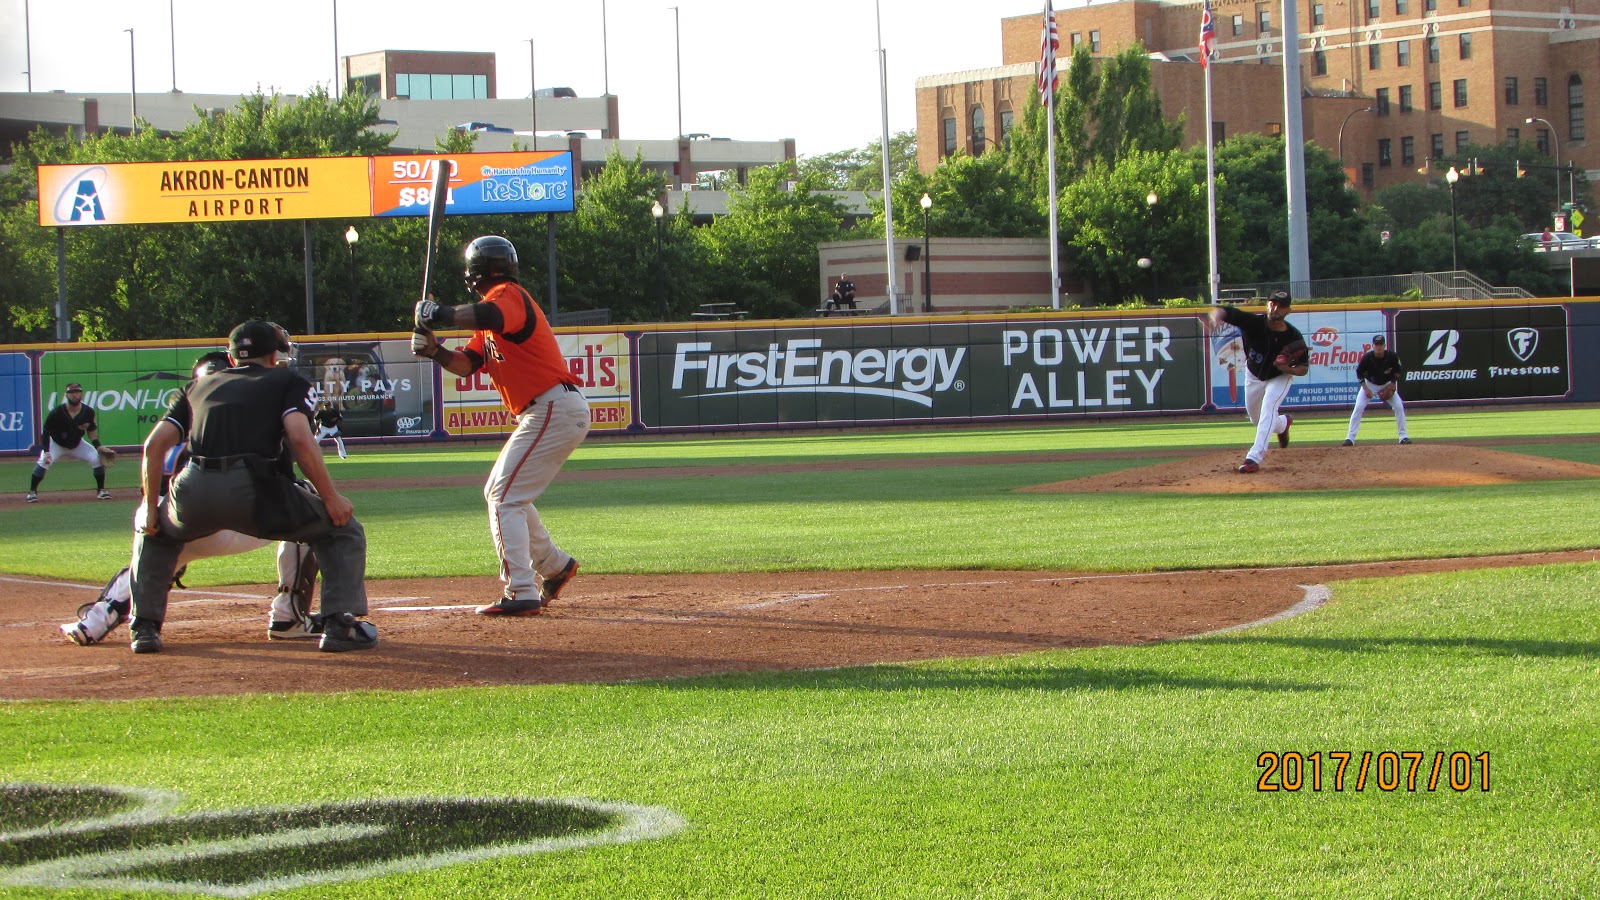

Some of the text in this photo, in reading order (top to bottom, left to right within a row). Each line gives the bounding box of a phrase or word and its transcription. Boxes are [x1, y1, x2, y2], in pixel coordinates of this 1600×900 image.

[160, 167, 309, 191] AKRON-CANTON
[393, 159, 459, 179] 50/0
[493, 166, 564, 176] Habitat for Humanity
[399, 187, 455, 207] $81
[482, 178, 567, 201] ReStore
[188, 197, 284, 217] AIRPORT
[1003, 326, 1173, 366] POWER
[1315, 332, 1336, 342] DQ
[671, 338, 966, 392] FirstEnergy
[1405, 369, 1477, 381] BRIDGESTONE
[1488, 365, 1560, 378] Firestone
[361, 379, 411, 393] PAYS
[1011, 369, 1165, 409] ALLEY
[1325, 386, 1358, 394] SPONSOR
[399, 417, 414, 428] AAA
